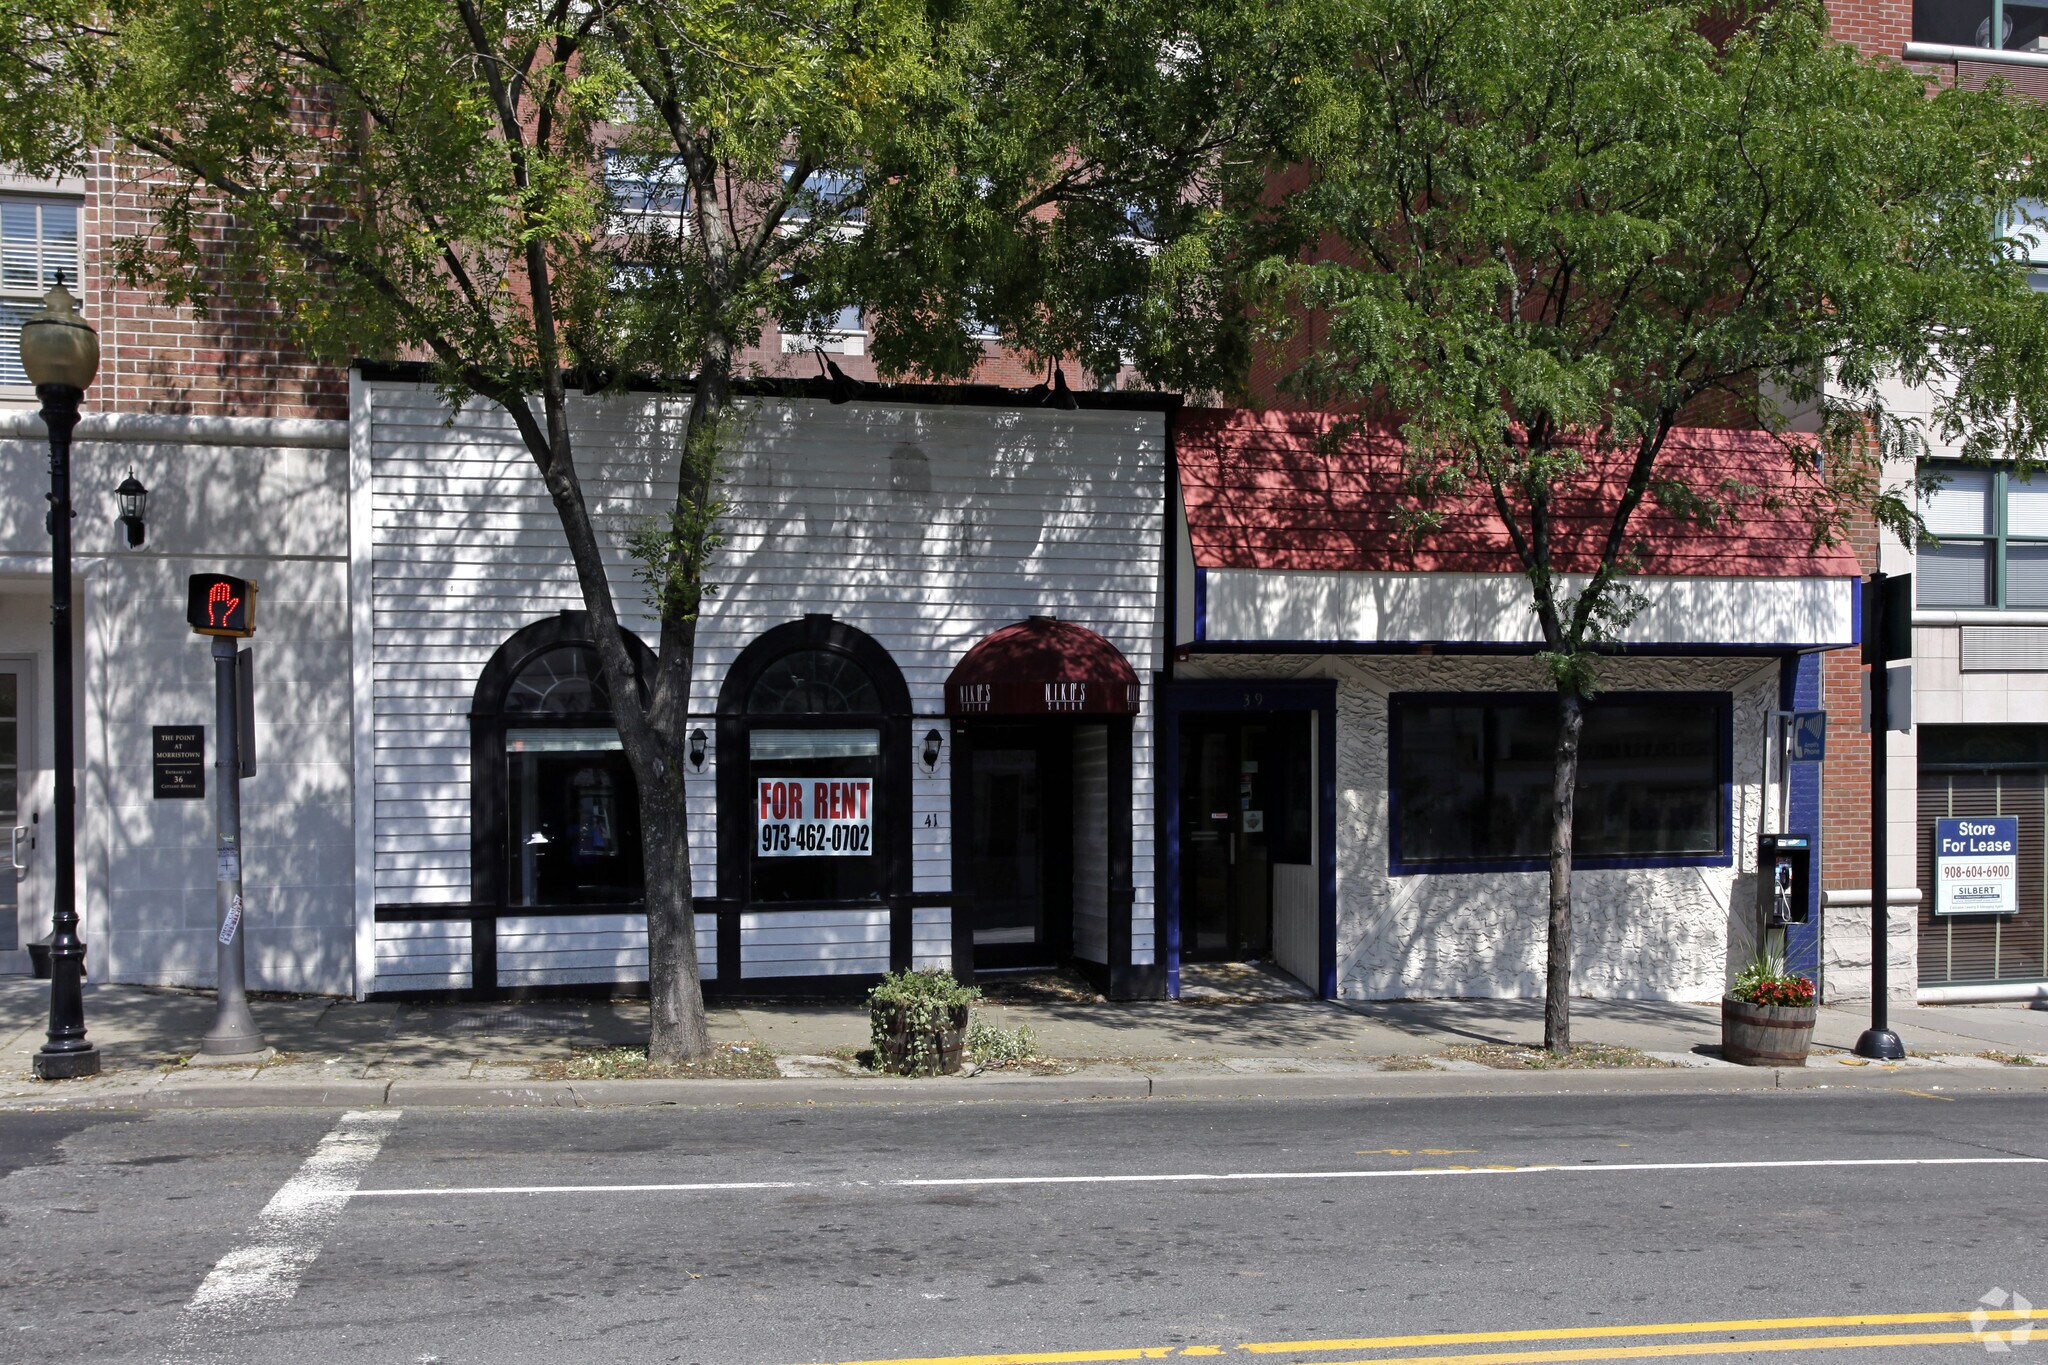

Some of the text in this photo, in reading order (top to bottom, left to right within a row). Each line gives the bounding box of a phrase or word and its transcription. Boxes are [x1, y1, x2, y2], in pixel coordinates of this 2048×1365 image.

[959, 683, 990, 702] NIKO'S
[1045, 682, 1086, 701] NIKO'S
[1242, 693, 1263, 707] 39
[174, 775, 184, 784] 36
[761, 781, 870, 820] FOR RENT
[924, 813, 938, 829] 41
[1959, 821, 1996, 836] Store
[762, 823, 870, 852] 973-462-0702
[1942, 838, 2012, 853] For Lease
[1944, 865, 2010, 878] 908-604-6900
[1958, 886, 1995, 895] SILBERT
